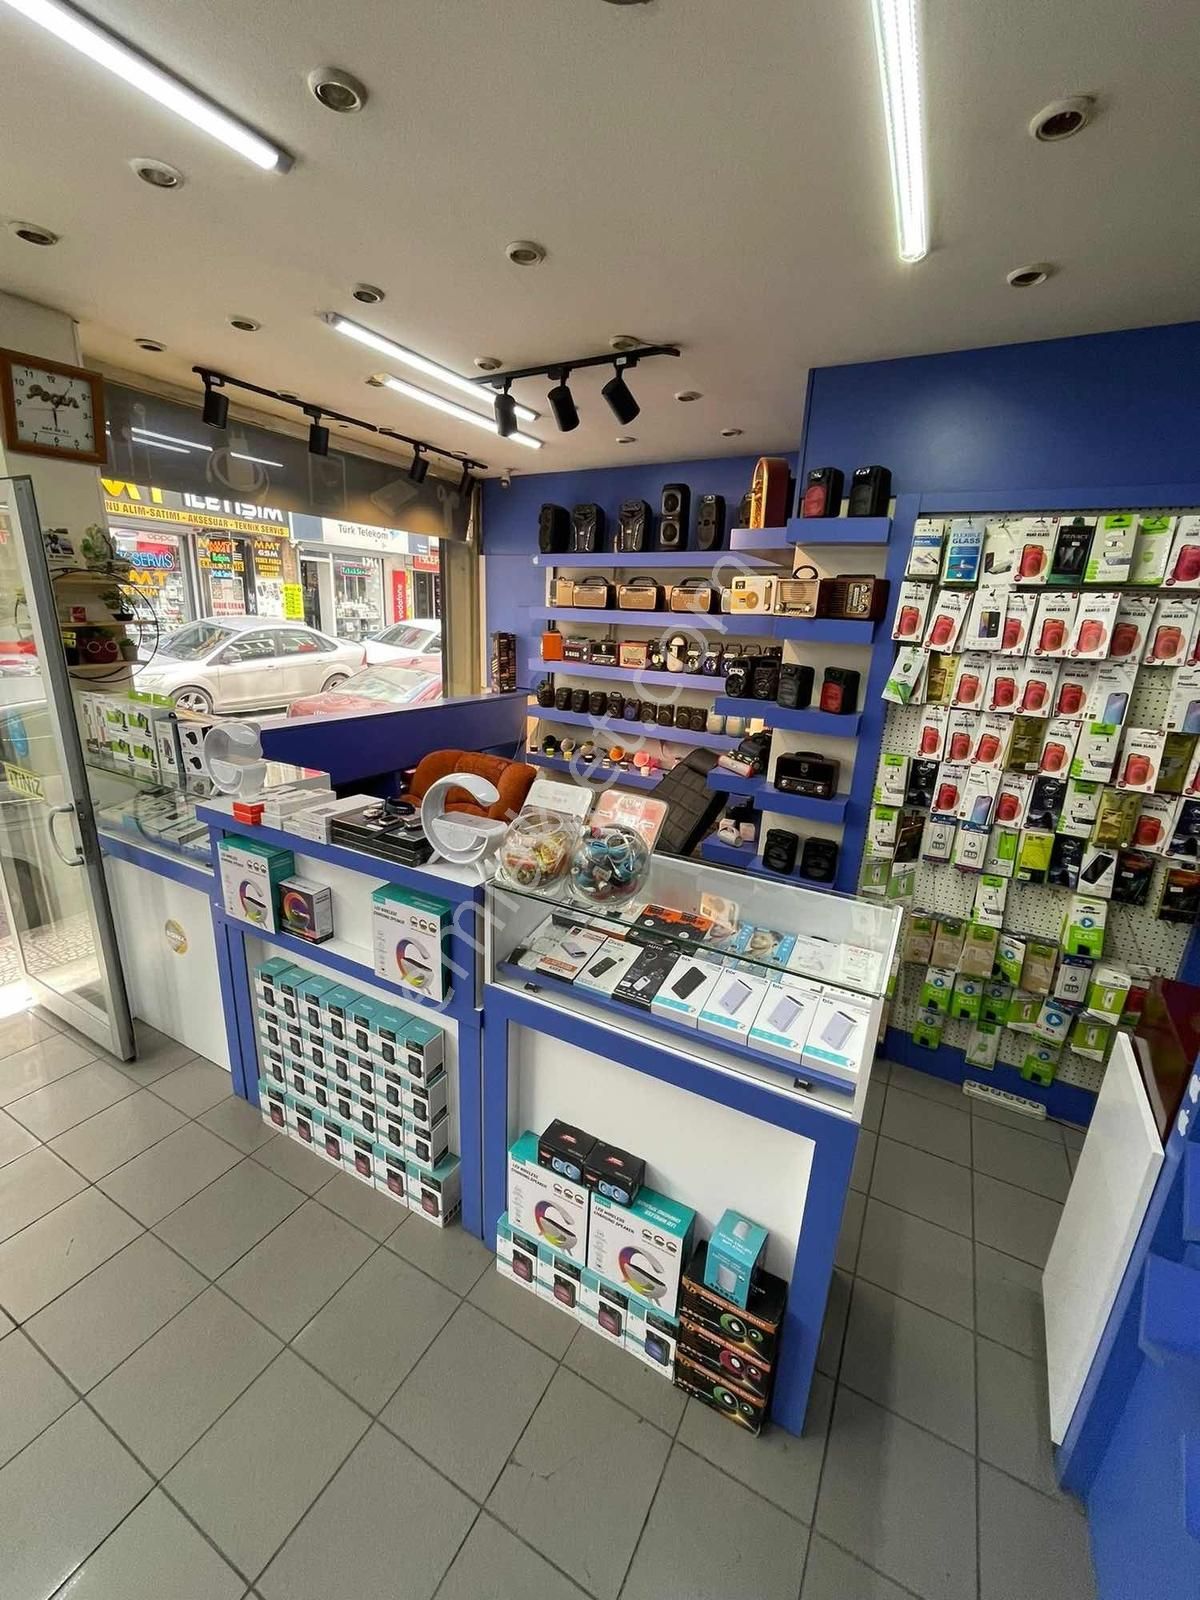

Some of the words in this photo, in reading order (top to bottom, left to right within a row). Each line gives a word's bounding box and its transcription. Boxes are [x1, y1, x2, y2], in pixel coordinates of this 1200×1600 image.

[188, 514, 229, 527] AKSESUAR
[338, 524, 356, 534] Türk
[358, 527, 389, 540] Telekom
[254, 541, 280, 550] MMT
